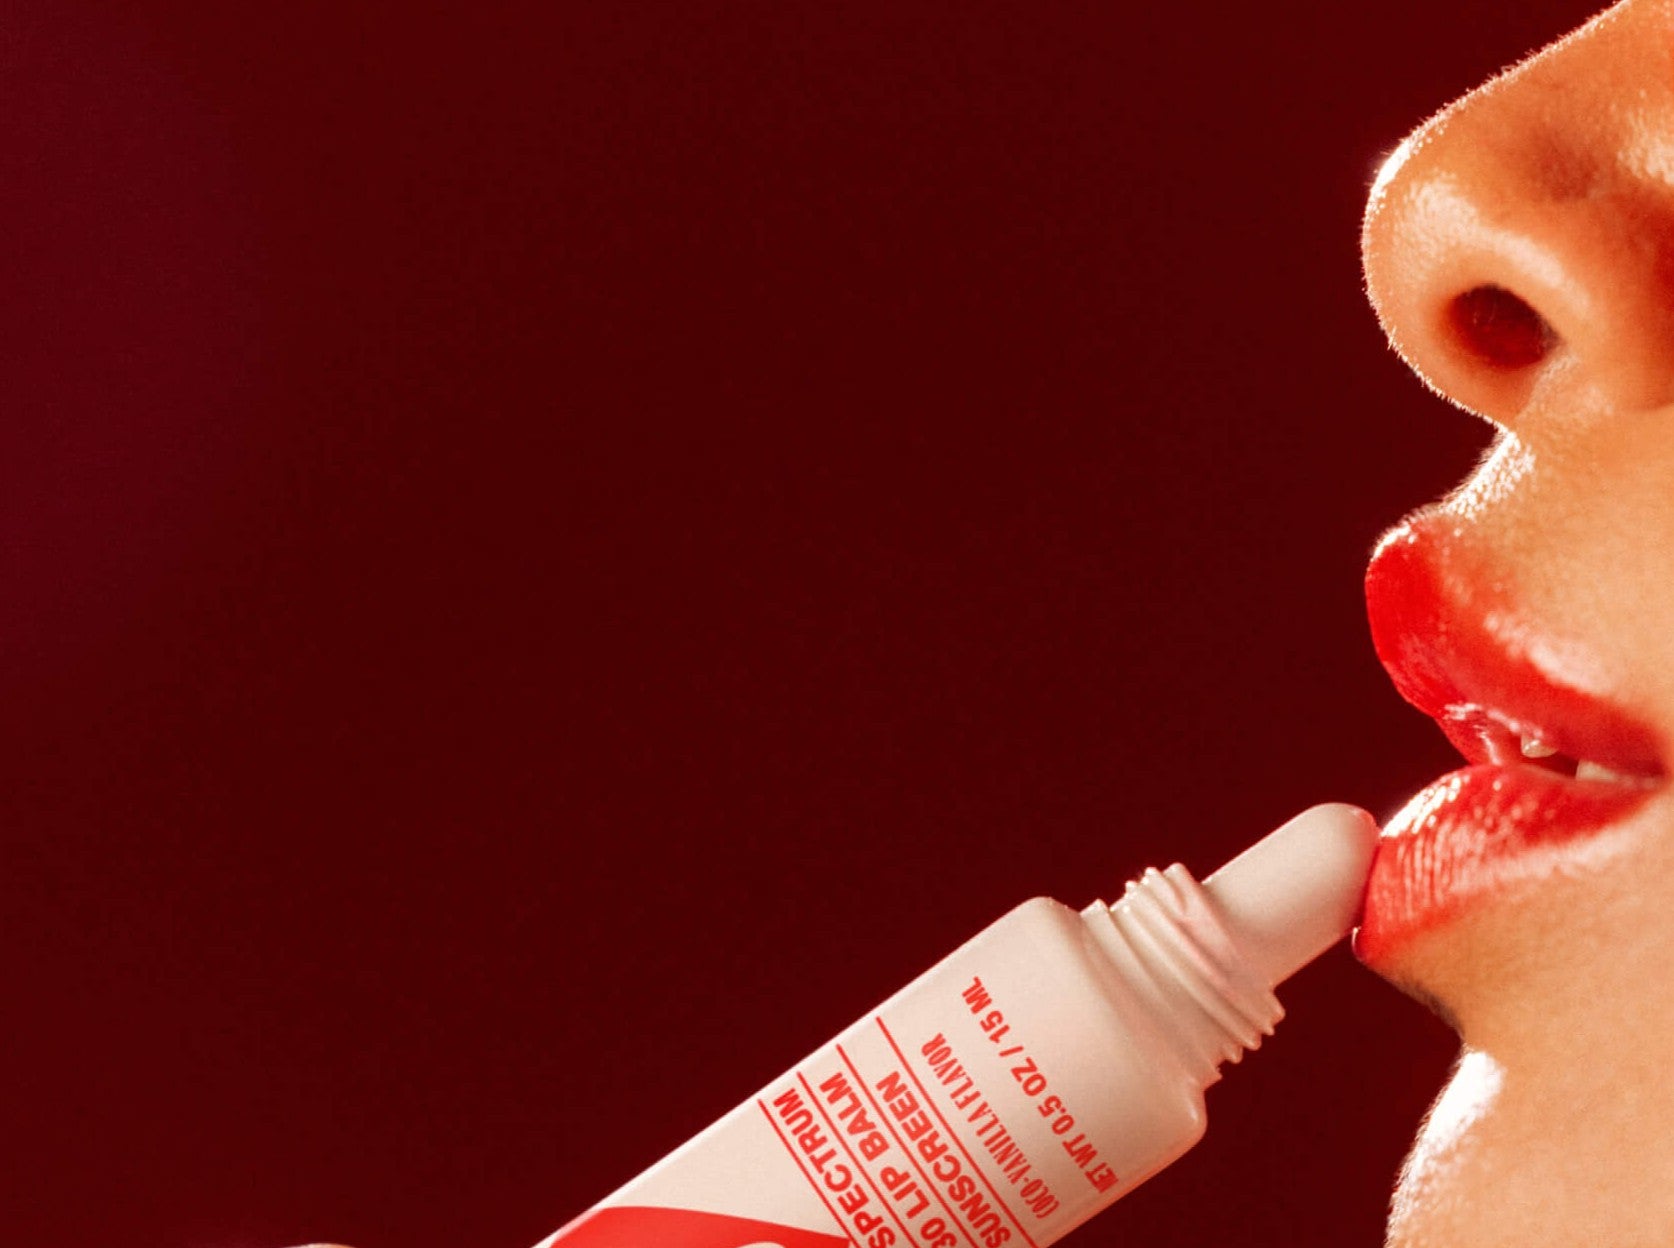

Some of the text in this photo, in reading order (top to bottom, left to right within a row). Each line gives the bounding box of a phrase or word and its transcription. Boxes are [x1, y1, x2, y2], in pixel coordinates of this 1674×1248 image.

[819, 1072, 890, 1163] BALM
[921, 1033, 1060, 1220] COCO-VANILLA FLAVOR
[961, 976, 1119, 1194] NET WT 0.5 OZ / 15 ML
[880, 1166, 931, 1220] LIP
